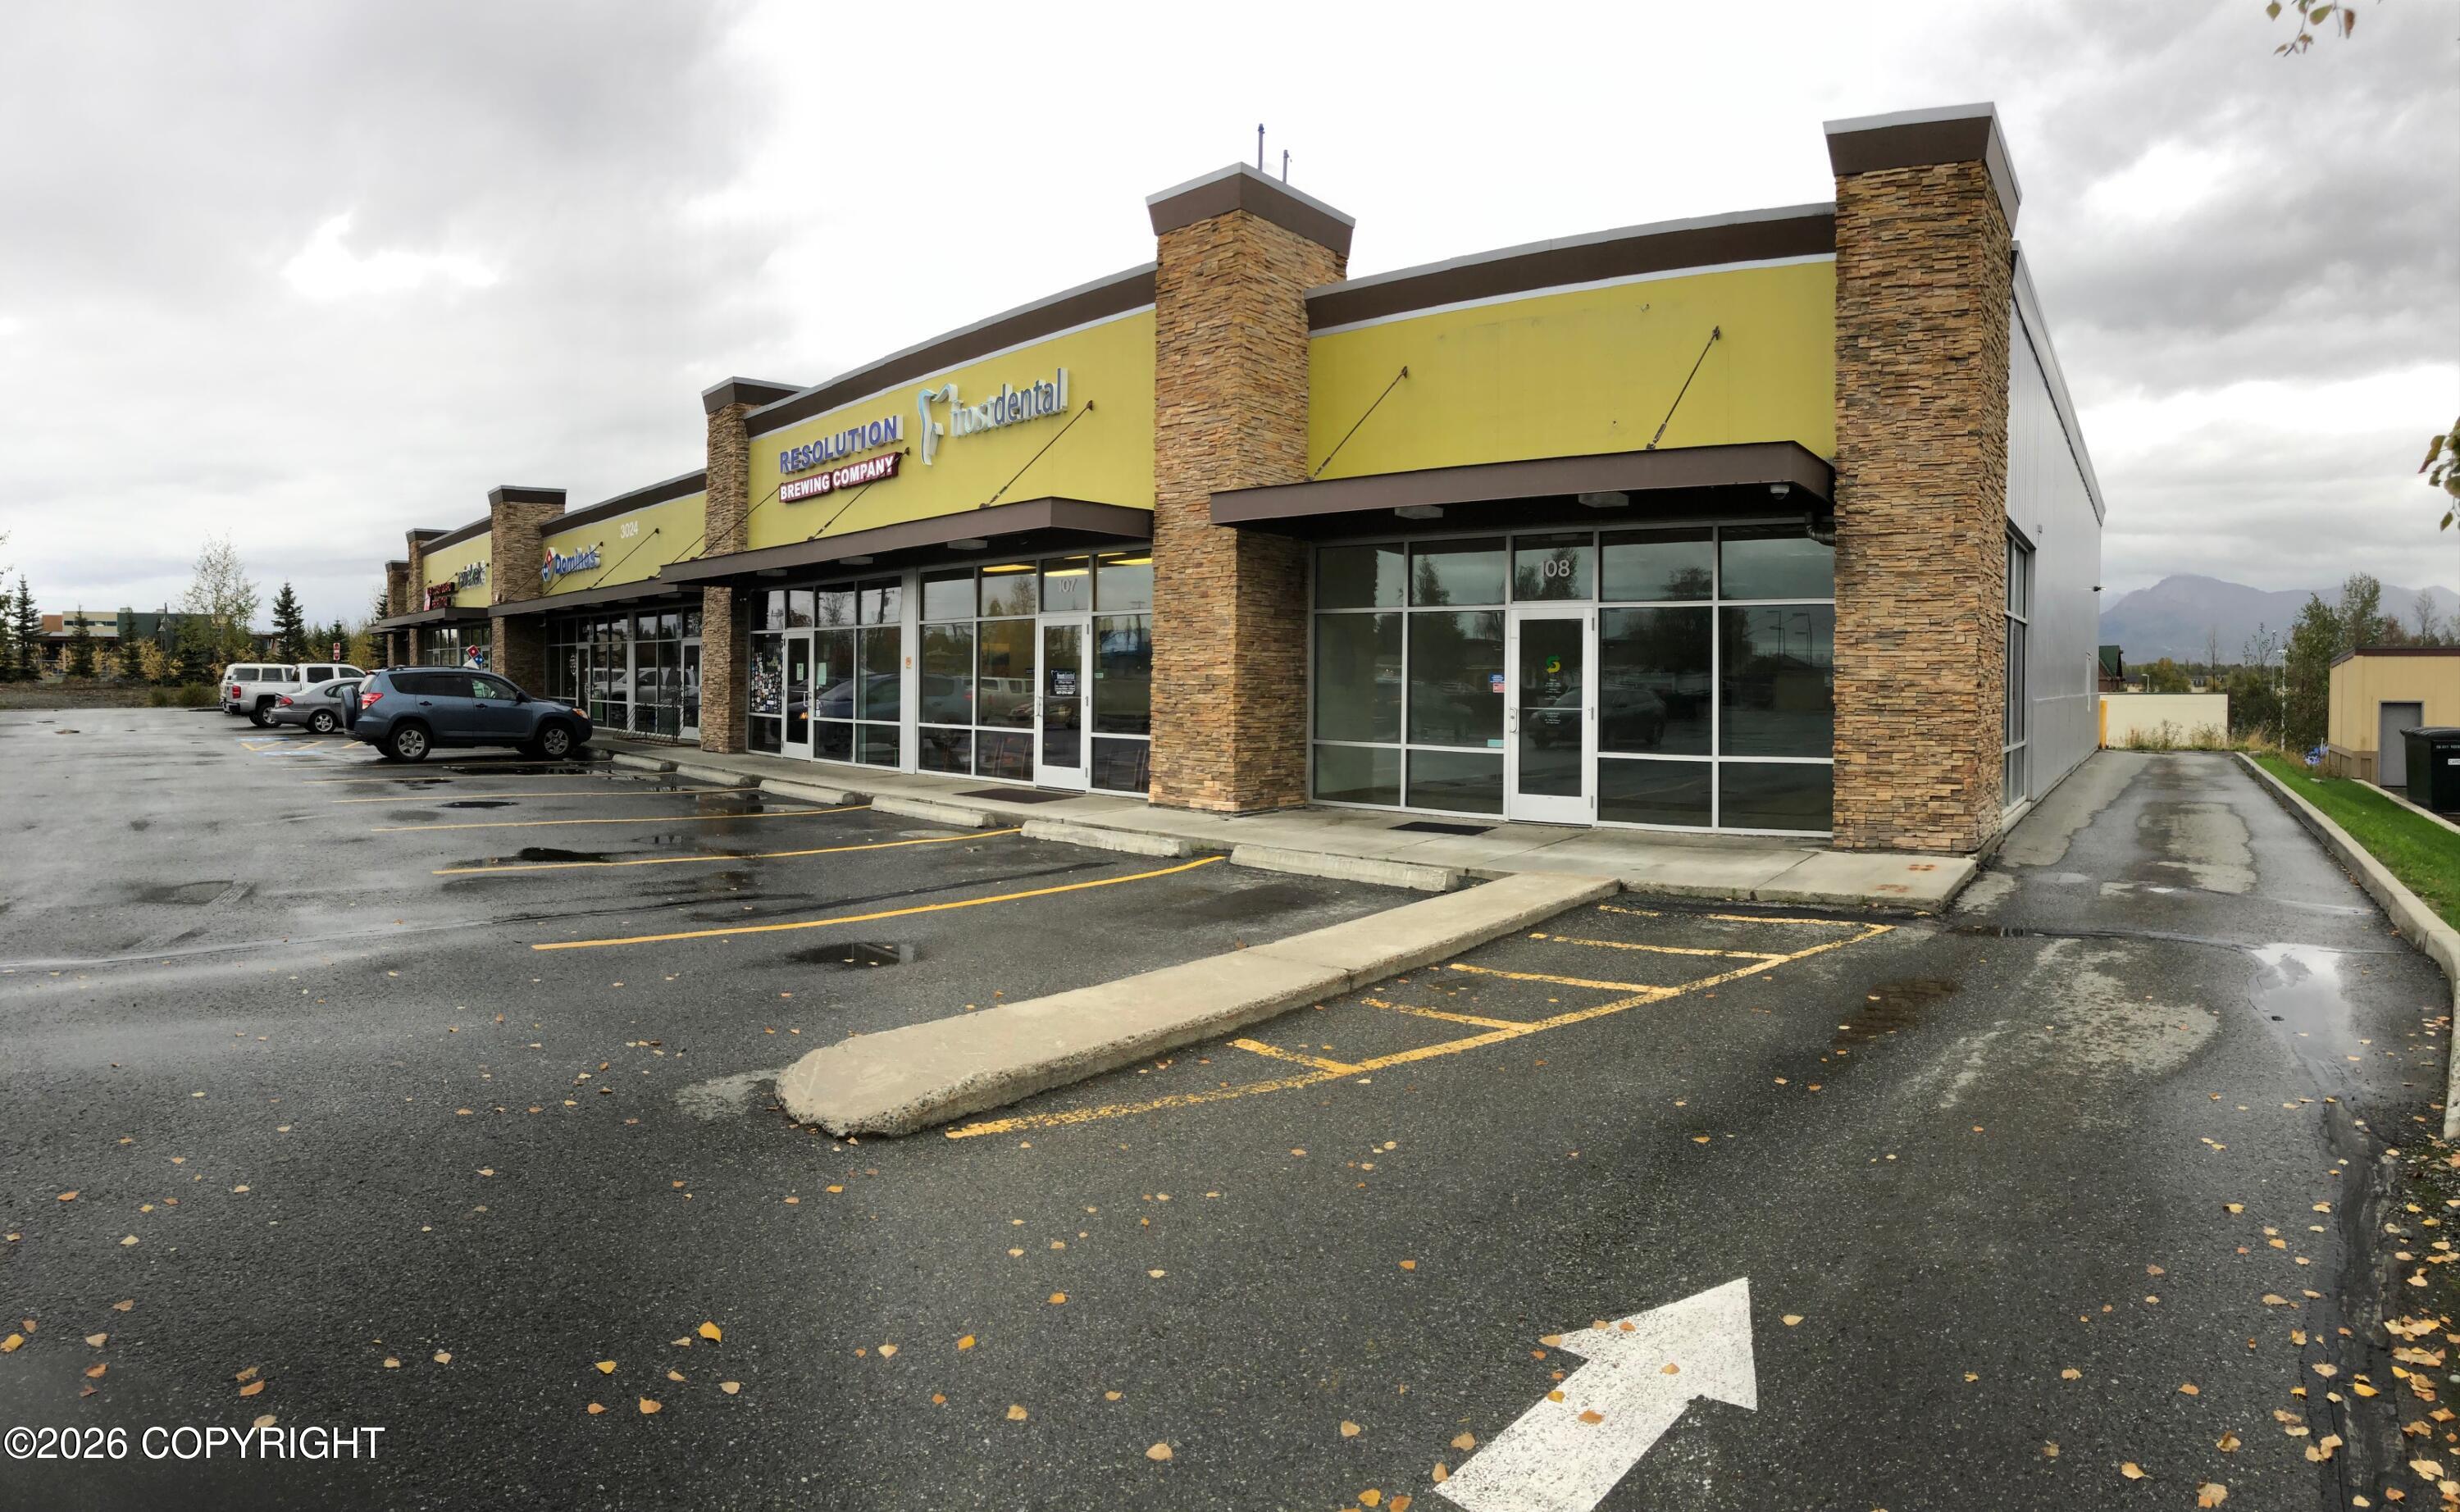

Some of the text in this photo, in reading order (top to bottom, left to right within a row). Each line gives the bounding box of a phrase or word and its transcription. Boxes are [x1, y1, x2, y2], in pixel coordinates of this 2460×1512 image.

[780, 415, 898, 473] RESOLUTION
[780, 455, 894, 500] BREWING COMPANY
[620, 521, 639, 539] 3024
[1538, 559, 1570, 577] 108
[1058, 576, 1077, 592] 107
